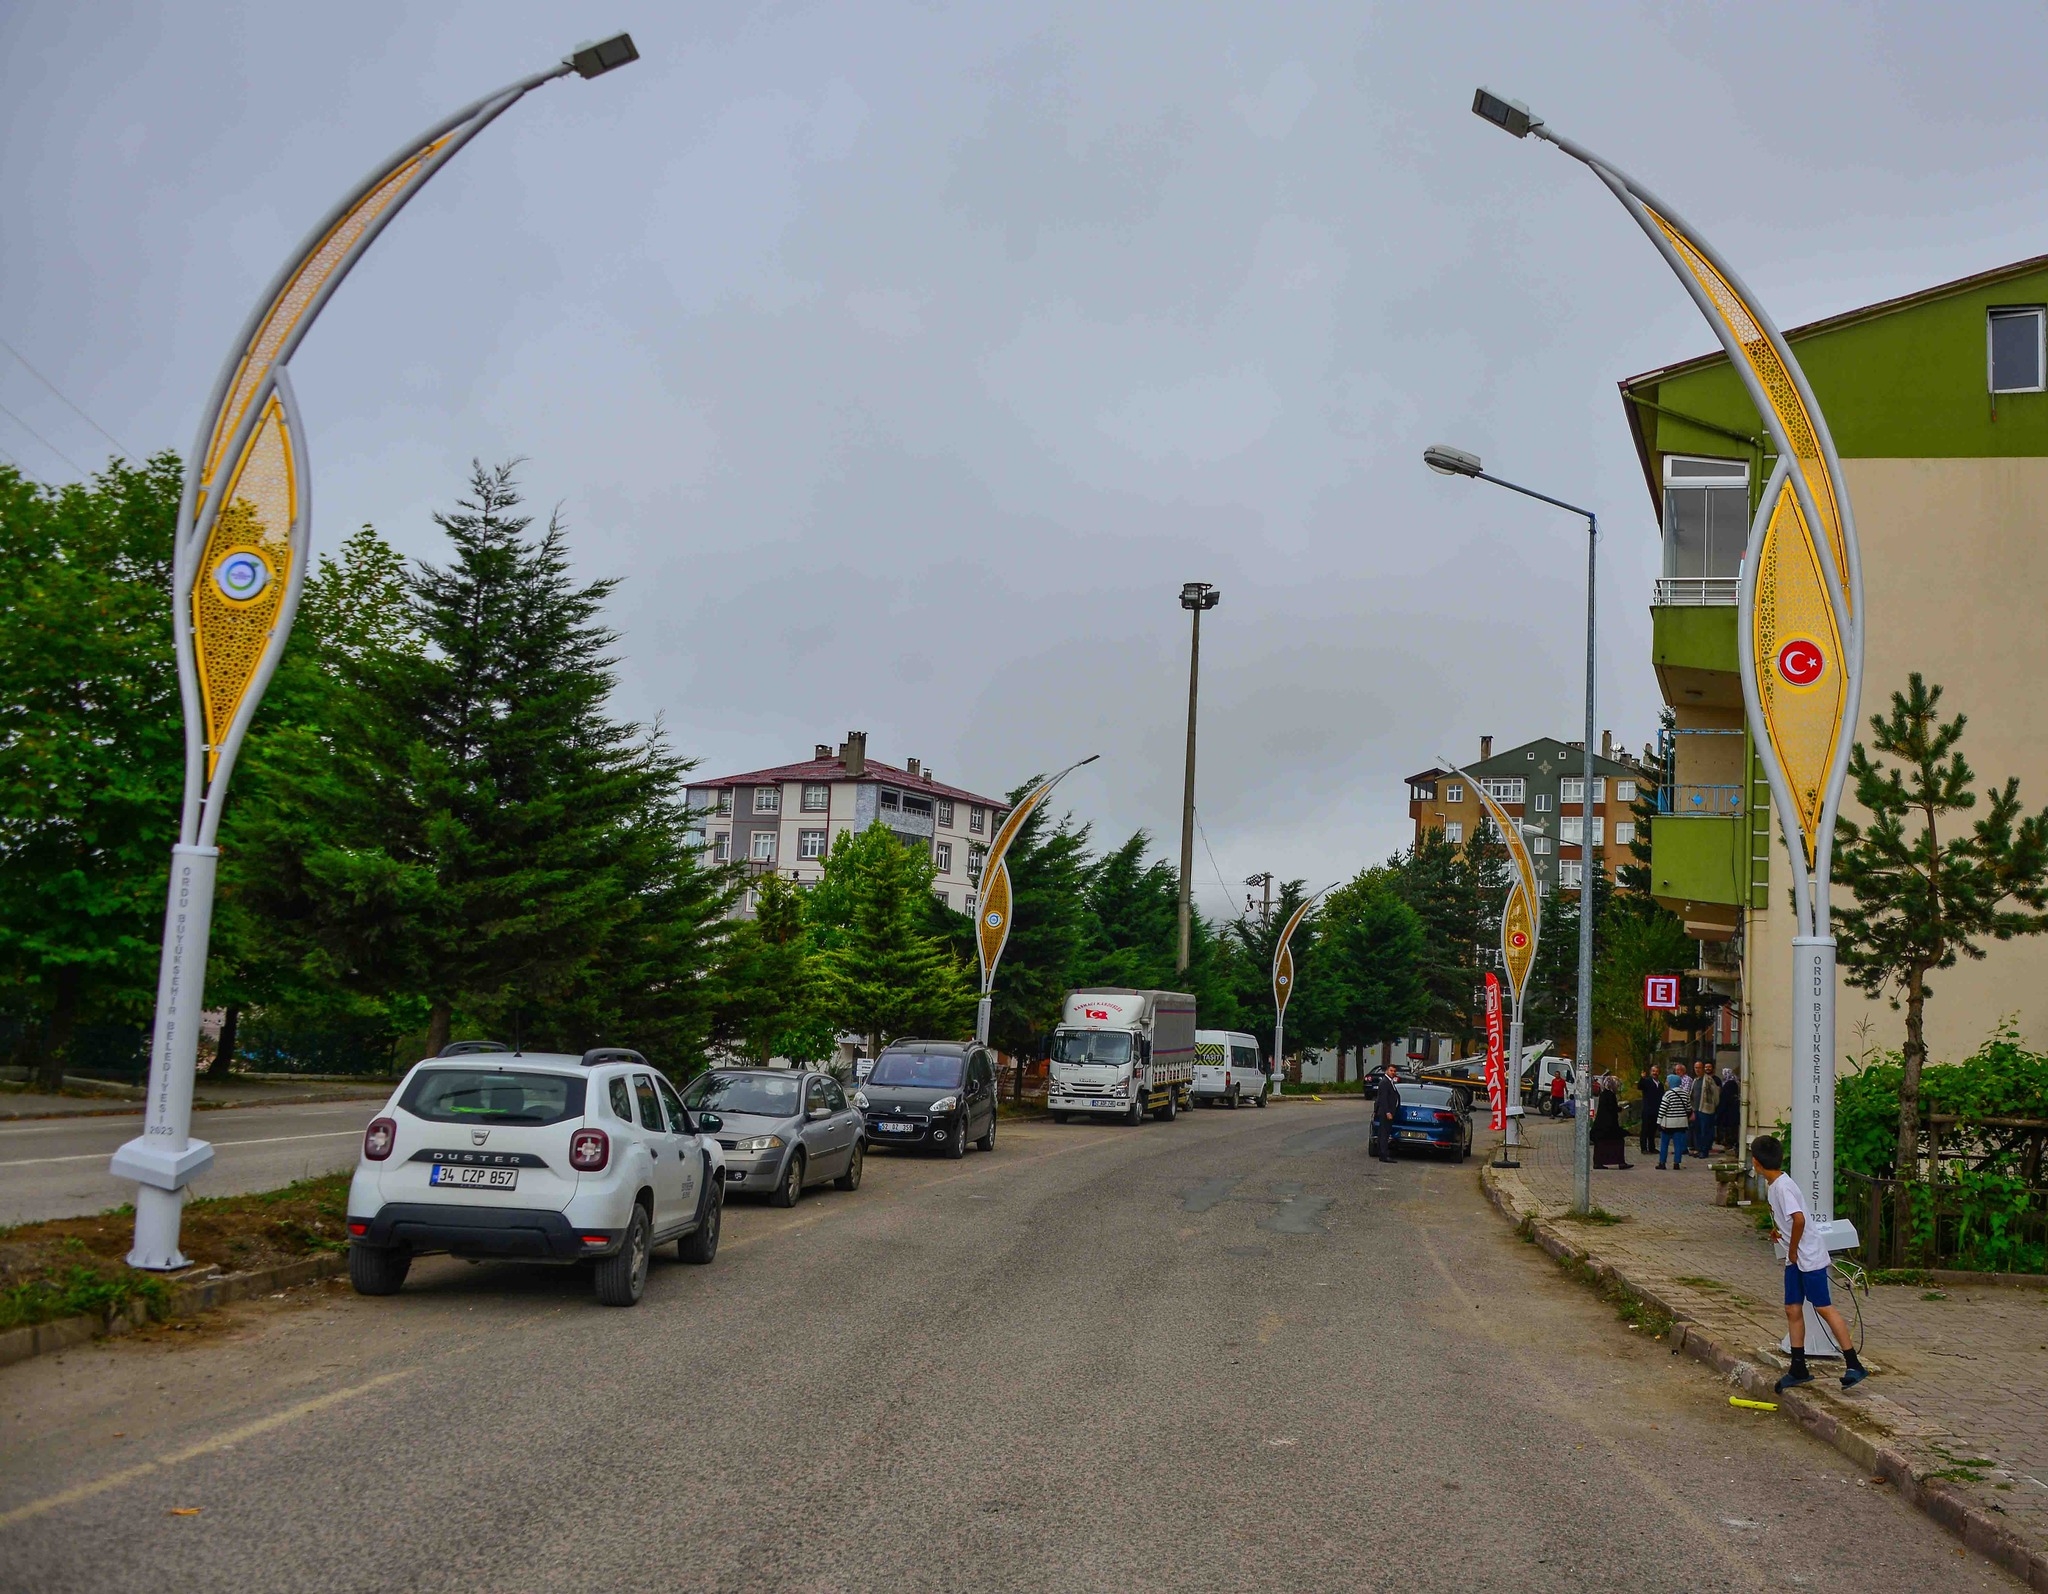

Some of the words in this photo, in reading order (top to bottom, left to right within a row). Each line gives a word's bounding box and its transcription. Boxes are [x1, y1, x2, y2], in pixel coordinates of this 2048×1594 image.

[179, 866, 191, 908] ORDU
[1813, 955, 1822, 997] ORDU
[1656, 984, 1668, 1001] E
[1812, 1002, 1821, 1104] BÜYÜKŞEHİR
[150, 1125, 174, 1135] 2023
[433, 1152, 520, 1164] DUSTER
[1812, 1109, 1820, 1211] BELEDİYESİ
[440, 1168, 454, 1182] 34
[462, 1169, 485, 1184] CZP
[490, 1170, 514, 1186] 857
[1810, 1213, 1827, 1222] 23
